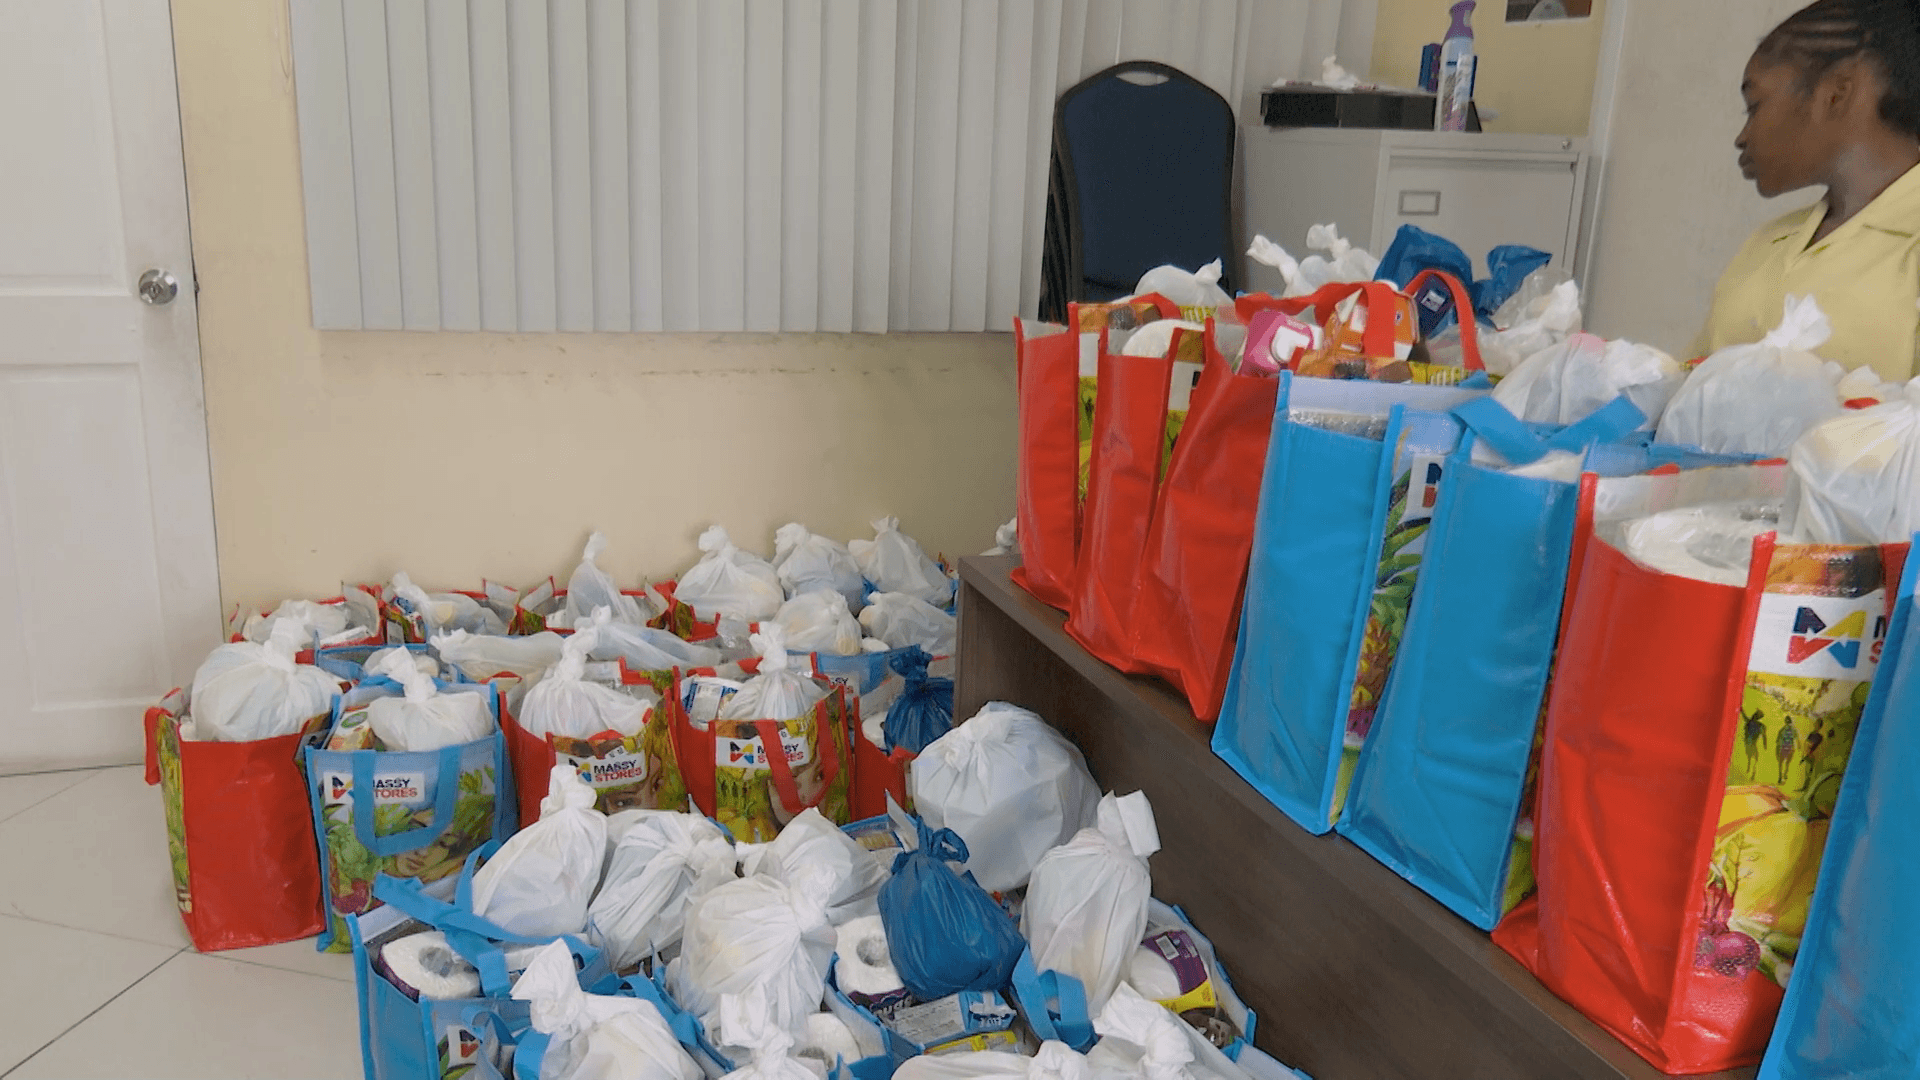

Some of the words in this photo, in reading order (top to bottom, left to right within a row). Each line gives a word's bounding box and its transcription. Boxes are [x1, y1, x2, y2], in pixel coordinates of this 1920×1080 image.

[594, 759, 637, 774] MASSY
[373, 777, 411, 788] ASSY
[374, 787, 418, 799] TORES
